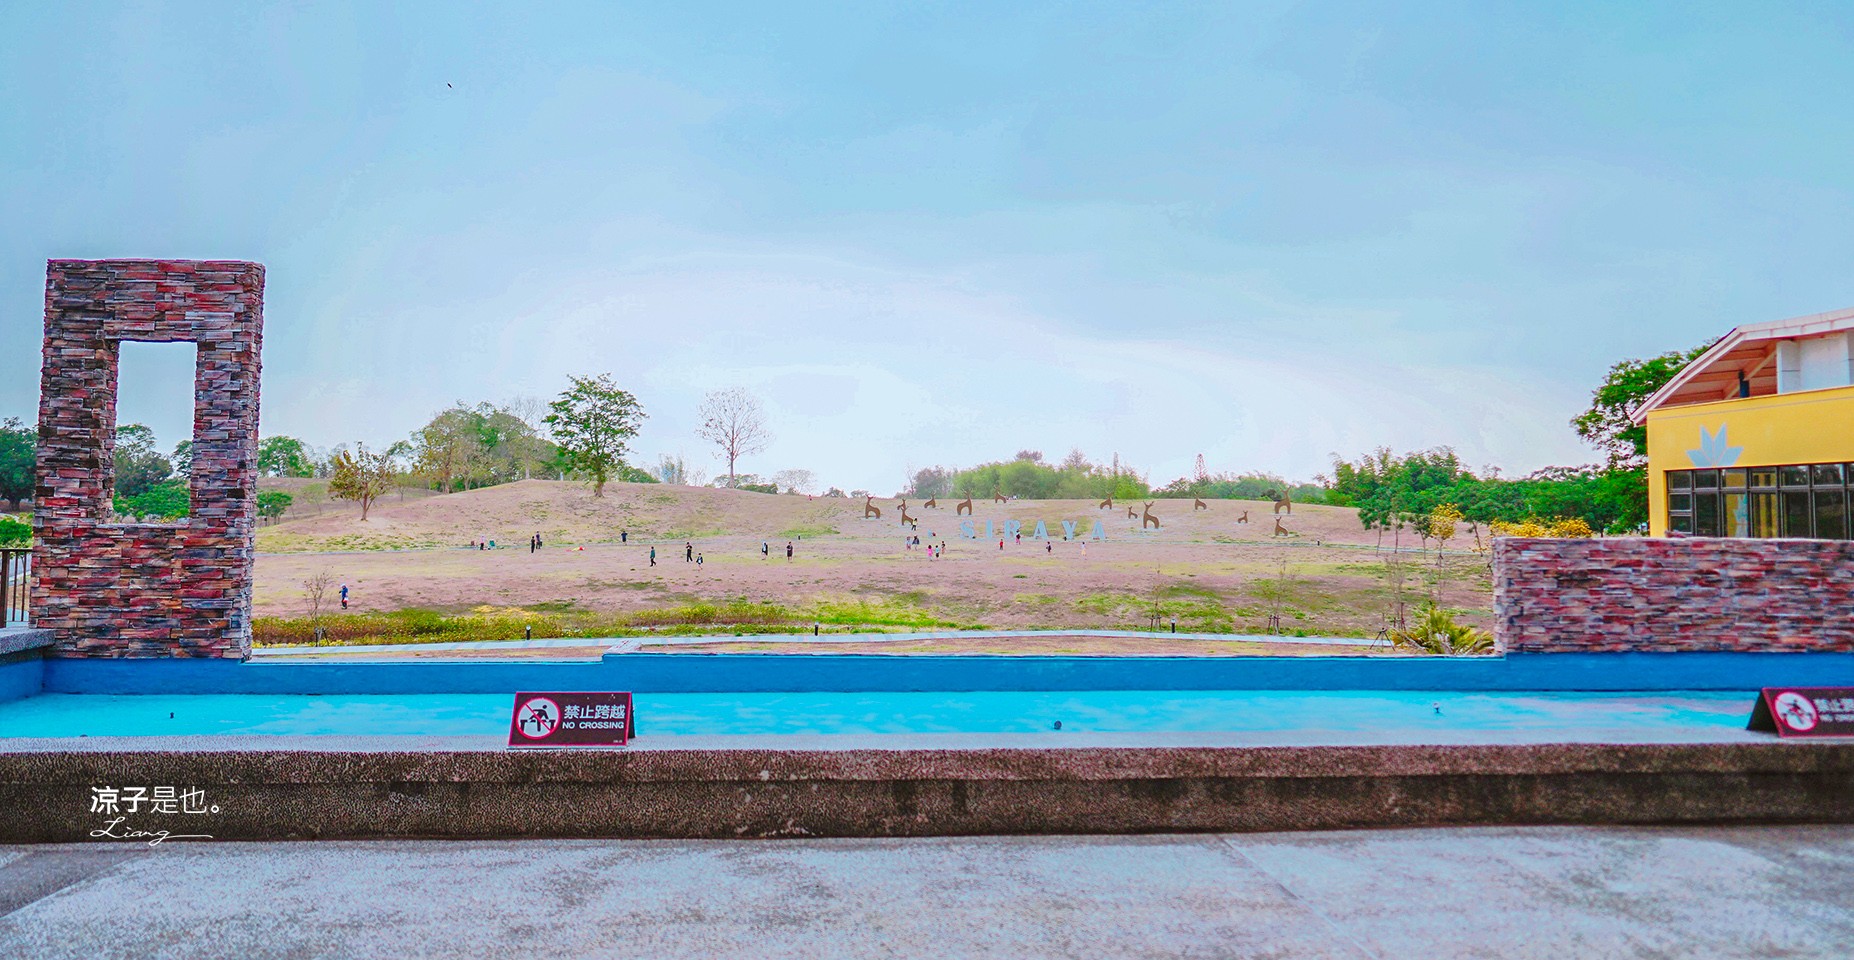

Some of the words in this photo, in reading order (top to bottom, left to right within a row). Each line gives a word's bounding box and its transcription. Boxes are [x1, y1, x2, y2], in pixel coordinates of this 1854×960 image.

[959, 519, 1106, 541] SIRAYA
[563, 704, 626, 719] 禁止跨越
[562, 721, 576, 729] NO
[579, 721, 624, 729] CROSSING
